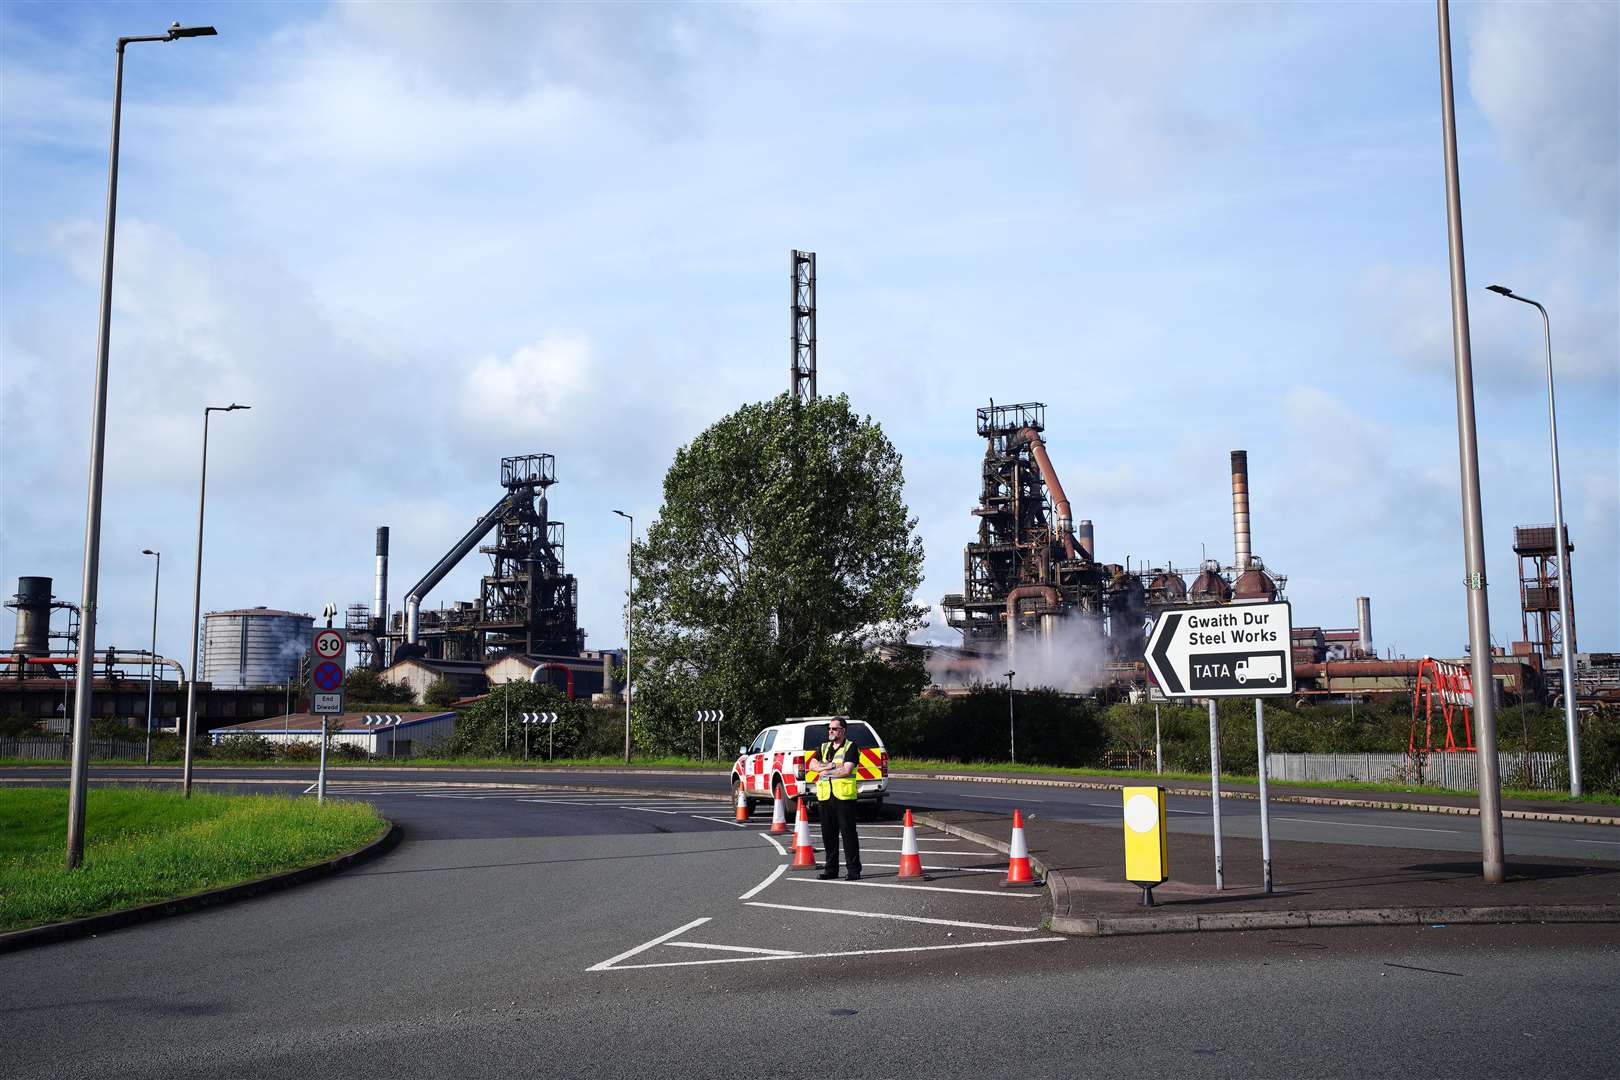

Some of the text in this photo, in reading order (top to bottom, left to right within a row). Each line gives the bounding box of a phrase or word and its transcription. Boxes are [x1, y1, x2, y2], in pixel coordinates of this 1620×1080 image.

[1188, 612, 1269, 628] Gwaith Dur
[1189, 629, 1277, 645] Steel Works
[320, 639, 340, 651] 30
[1193, 664, 1230, 678] TATA
